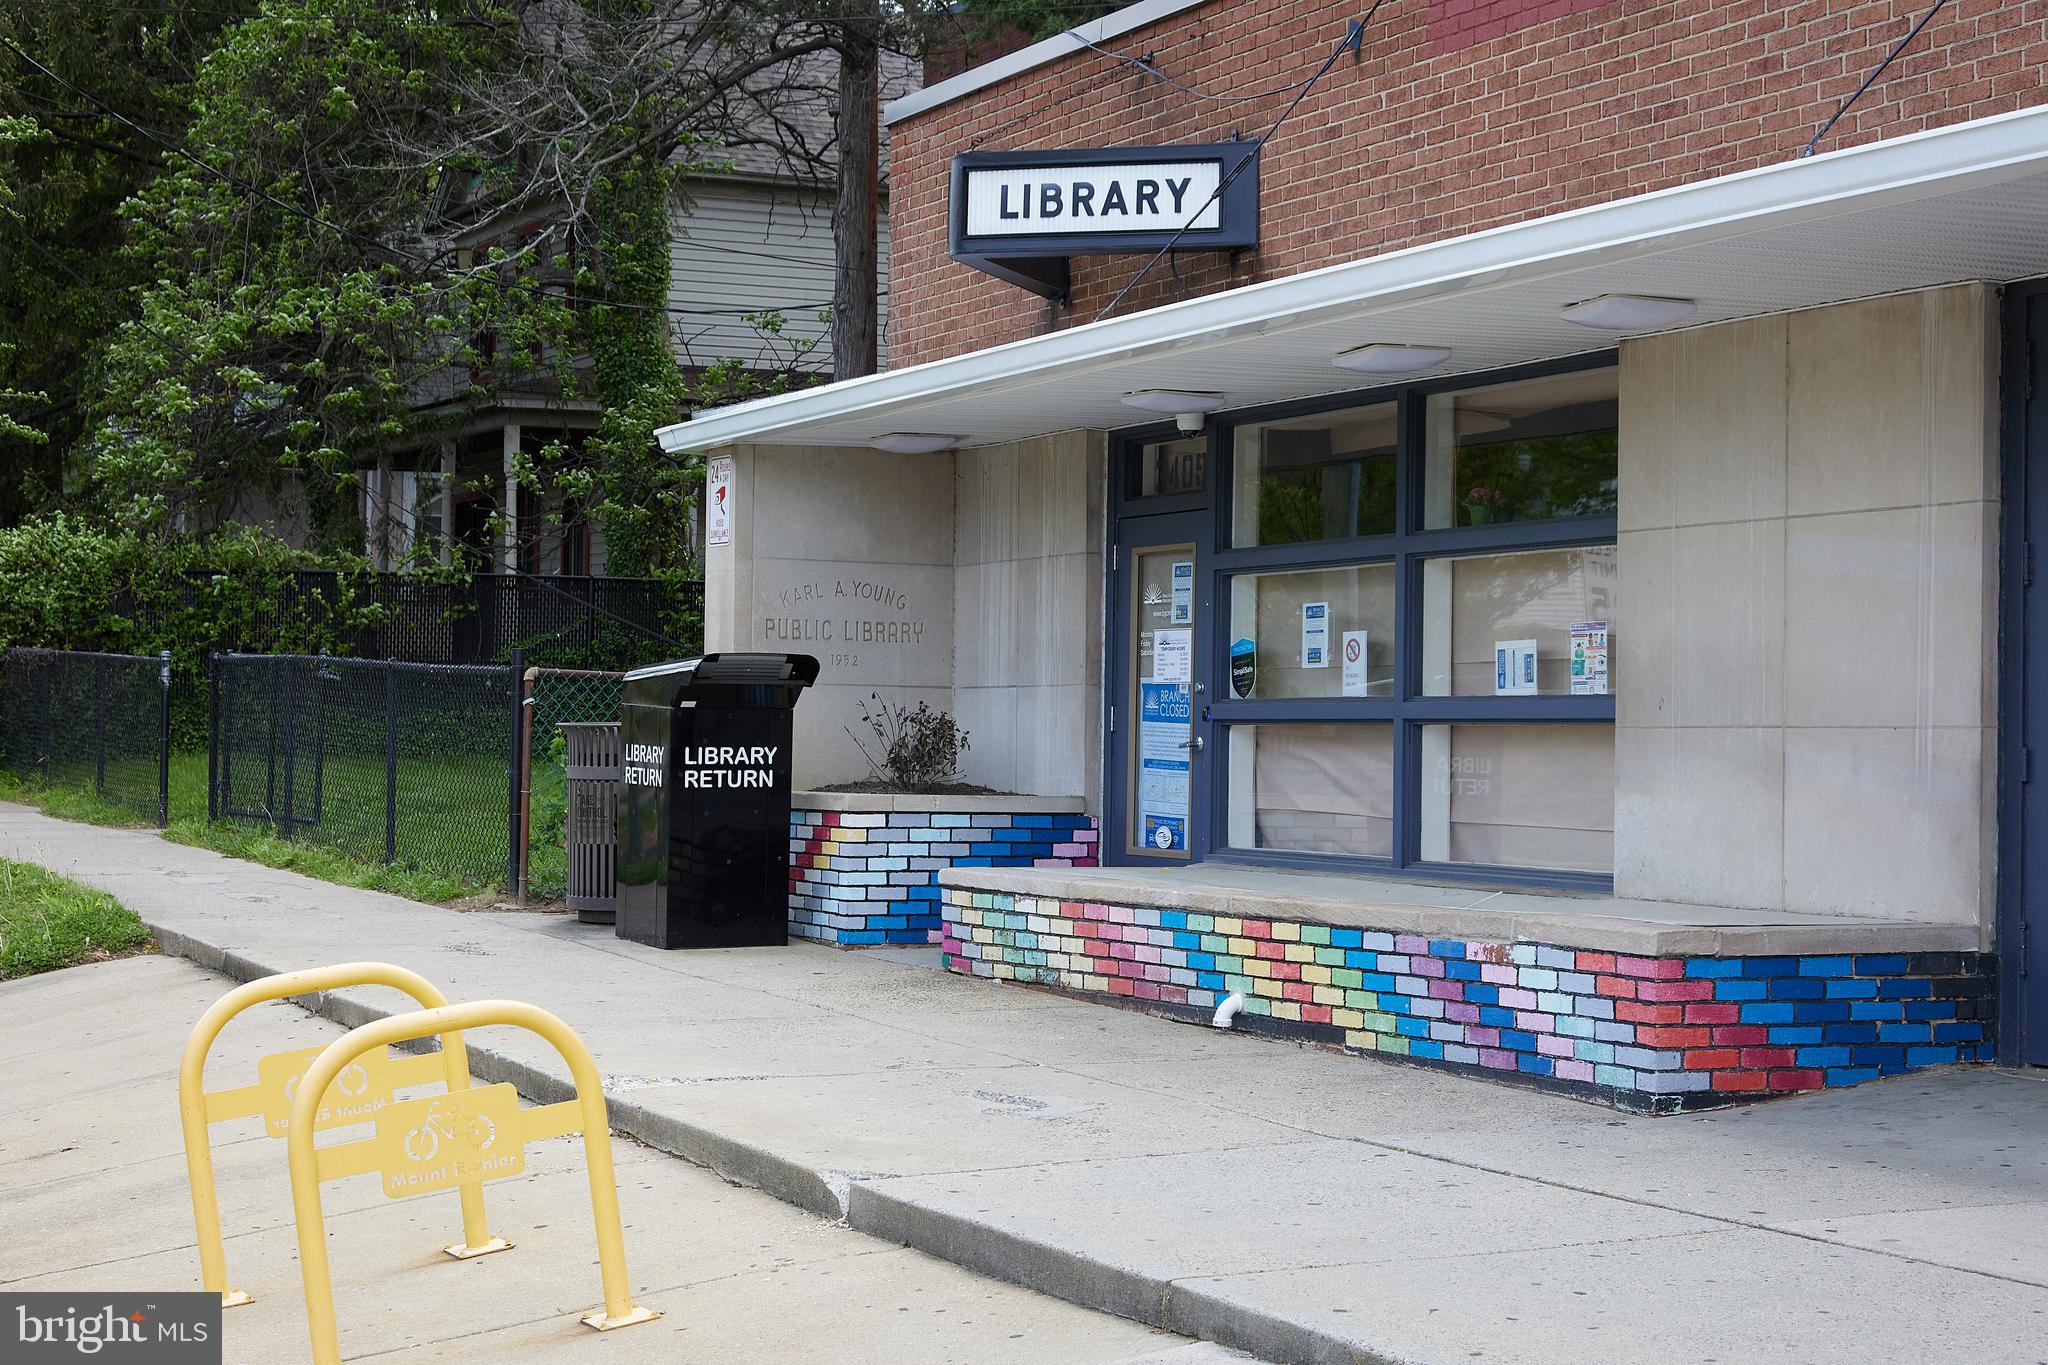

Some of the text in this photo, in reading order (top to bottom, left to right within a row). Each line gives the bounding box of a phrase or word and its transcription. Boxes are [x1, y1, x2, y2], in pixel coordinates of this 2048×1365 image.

[1000, 177, 1192, 219] LIBRARY
[712, 464, 719, 484] 24
[780, 580, 907, 610] KARL A. YOUNG
[765, 618, 924, 643] PUBLIC LIBRARY
[831, 654, 858, 666] 1952
[1160, 690, 1190, 703] BRANCH
[1160, 703, 1190, 718] CLOSED
[625, 743, 665, 764] LIBRARY
[684, 746, 778, 766] LIBRARY
[625, 766, 663, 788] RETURN
[684, 769, 774, 789] RETURN
[391, 1167, 447, 1189] Mount
